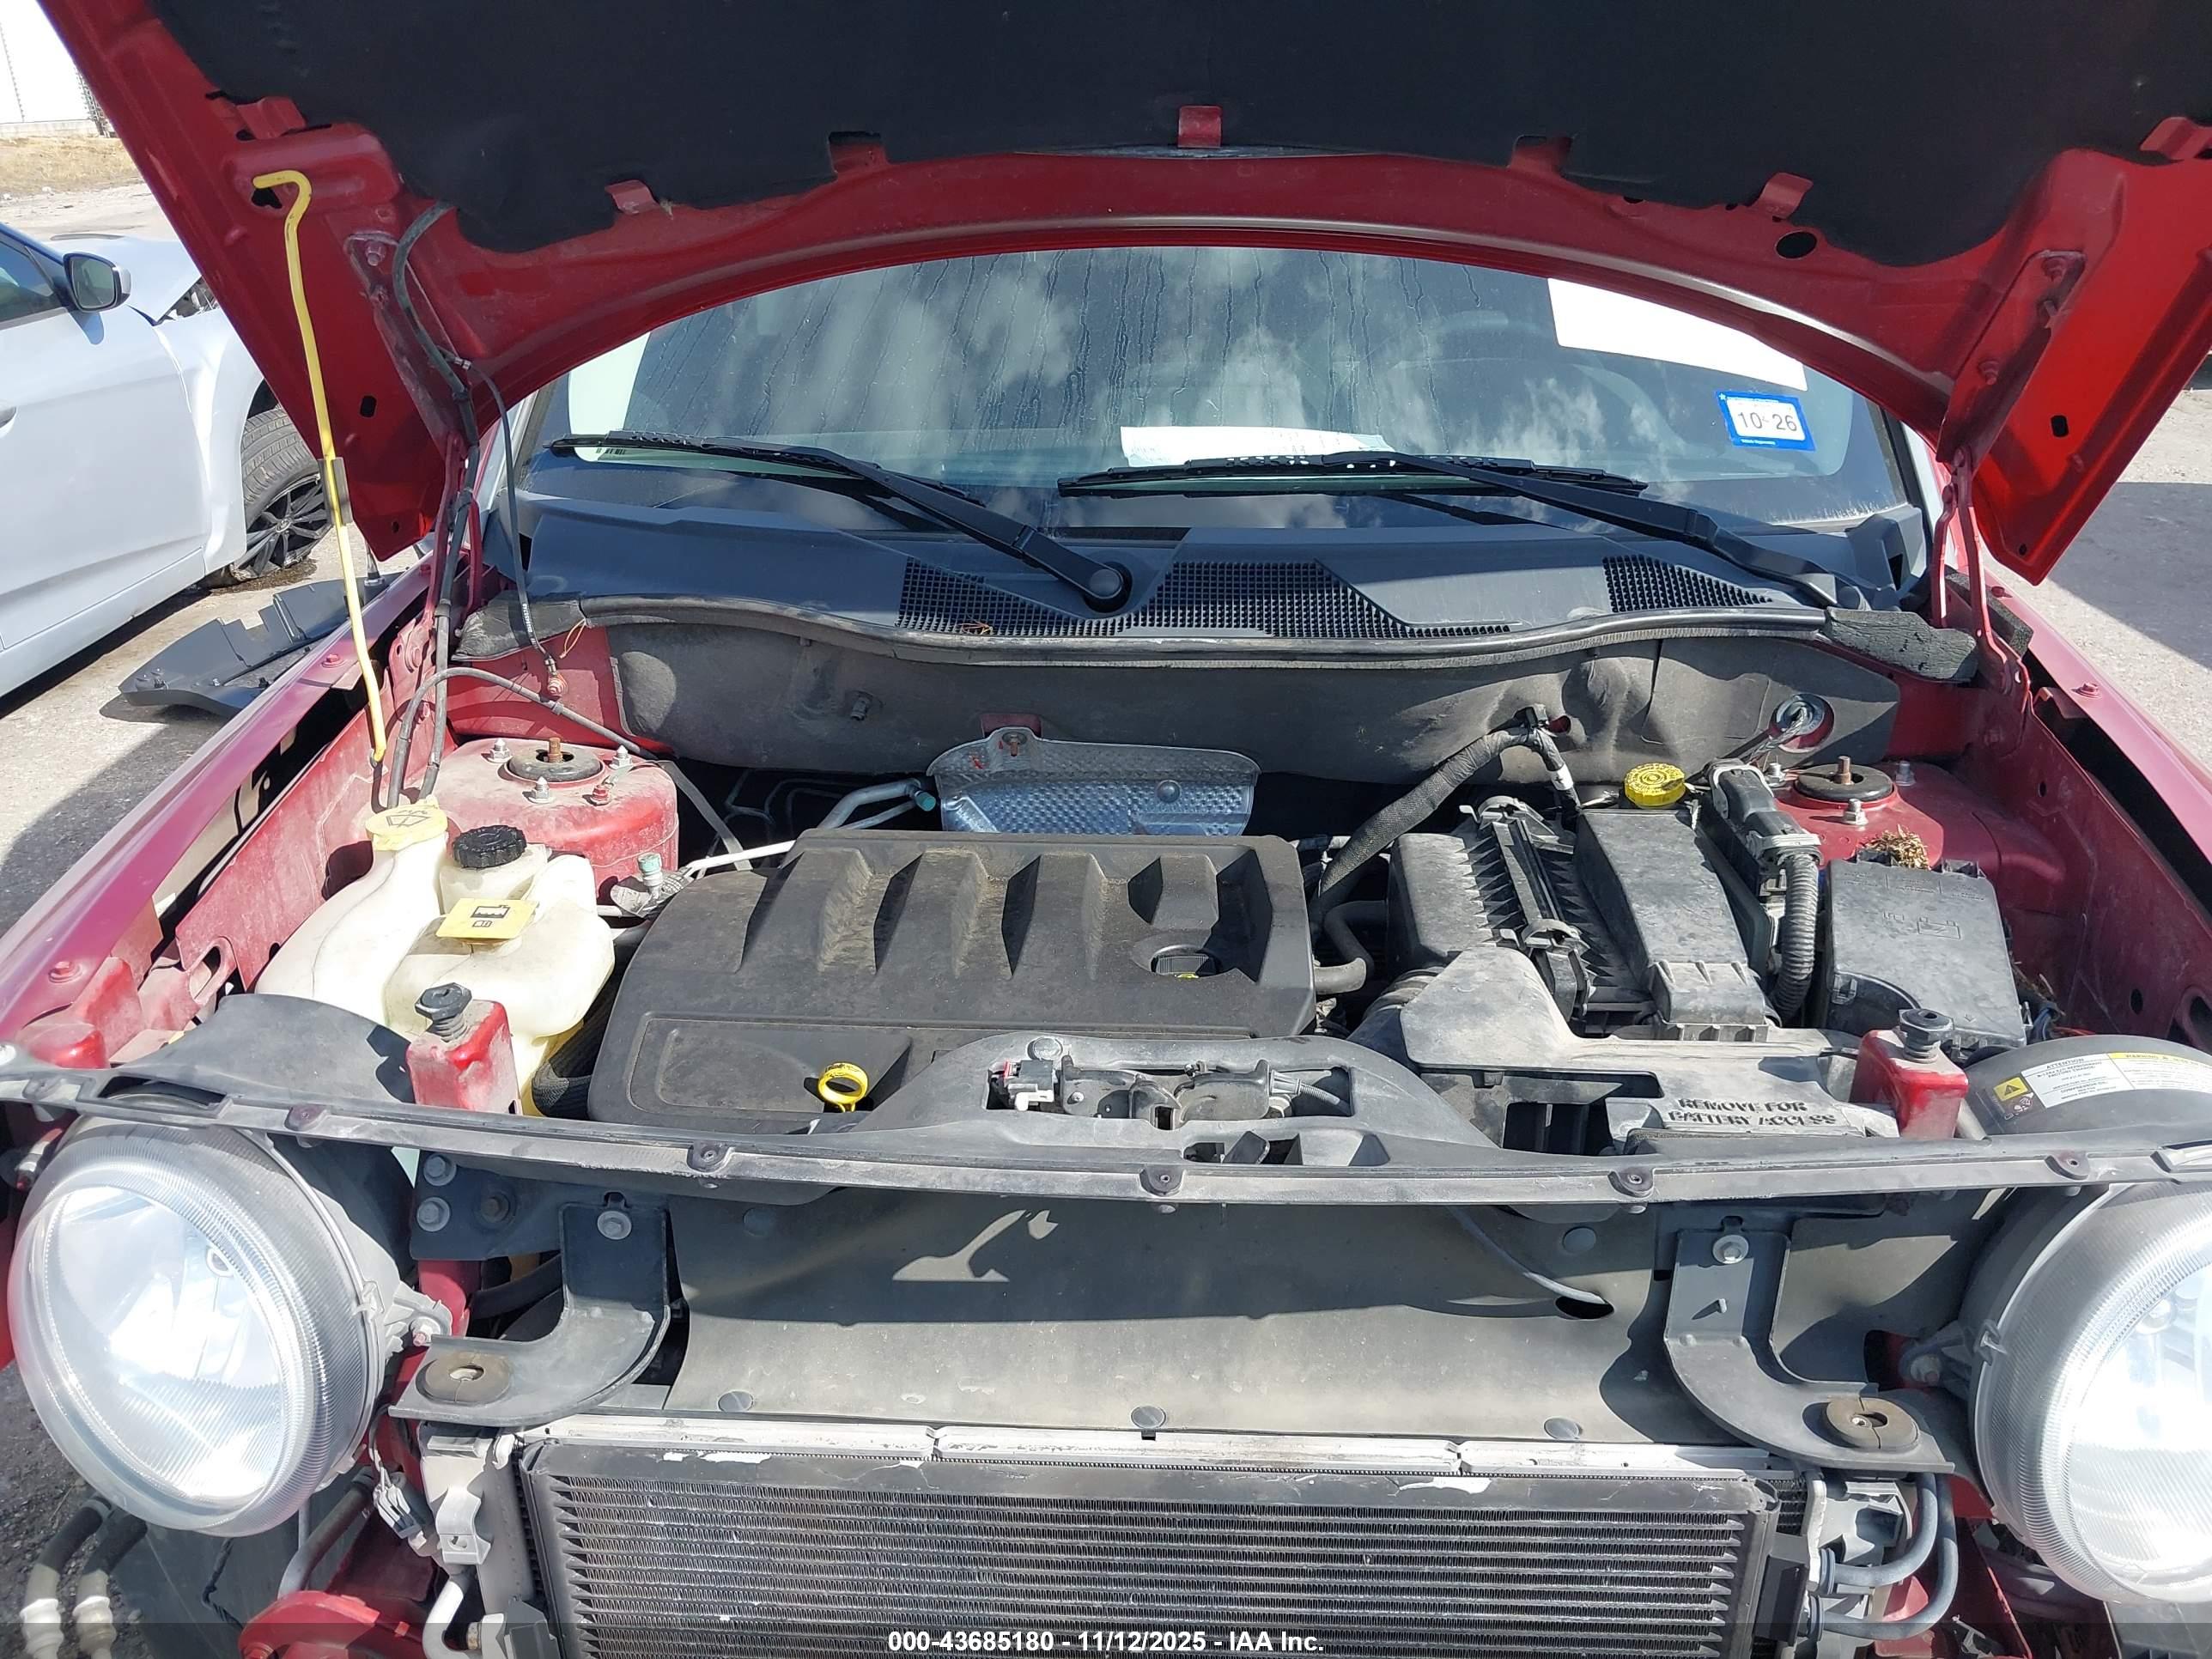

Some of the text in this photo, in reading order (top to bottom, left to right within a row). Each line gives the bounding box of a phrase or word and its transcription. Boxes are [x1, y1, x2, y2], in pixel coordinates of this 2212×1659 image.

[1737, 412, 1797, 432] 10 26
[2046, 1058, 2085, 1069] ATTENTION
[1678, 1098, 1808, 1112] REMOVE FOR
[1668, 1110, 1837, 1126] BATTERY ACCESS
